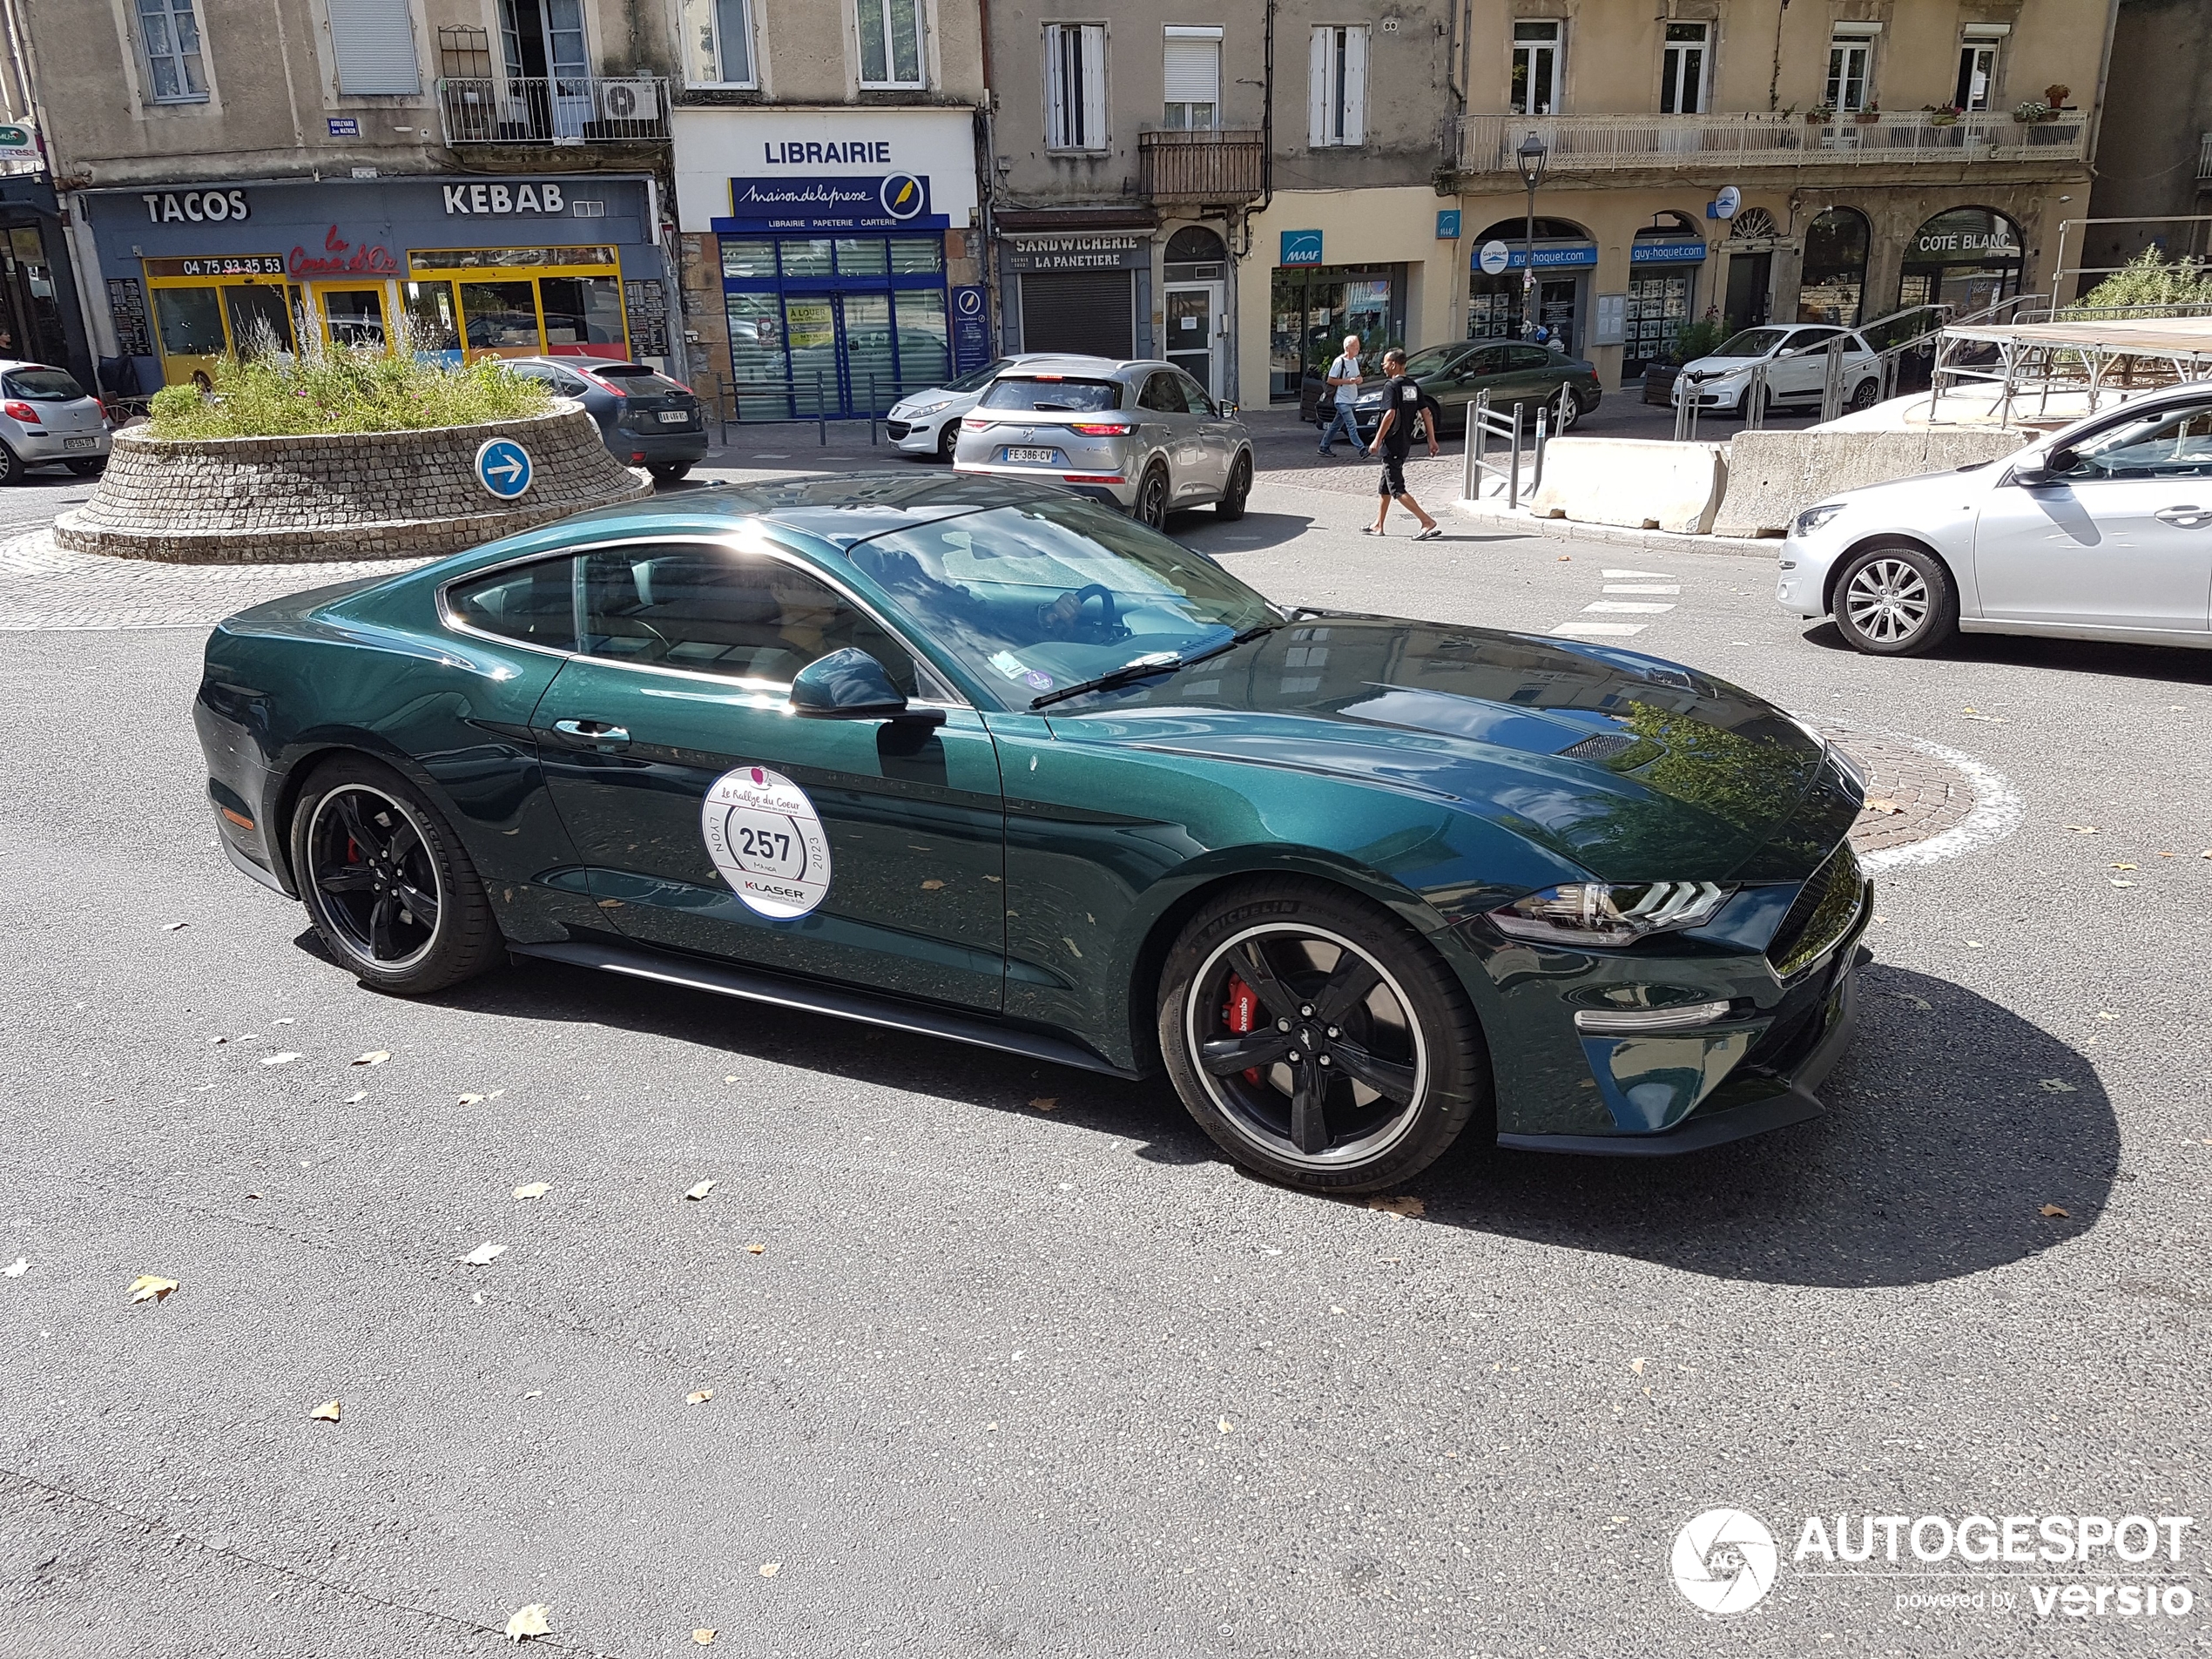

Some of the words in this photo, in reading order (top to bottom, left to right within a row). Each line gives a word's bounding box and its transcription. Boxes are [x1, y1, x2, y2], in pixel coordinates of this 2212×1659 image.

[764, 142, 891, 164] LIBRAIRIE
[143, 190, 248, 223] TACOS
[442, 184, 564, 214] KEBAB
[739, 184, 874, 209] maisondelapresse
[860, 218, 897, 226] CARTERIE
[1016, 236, 1137, 253] SANDWICHERIE
[1919, 232, 1958, 252] COTÉ
[1962, 233, 2011, 250] BLANC
[1035, 256, 1050, 268] LA
[1053, 254, 1121, 267] PANETIERE
[1286, 250, 1320, 261] MAAF
[1635, 246, 1702, 260] guy-hoquet.com
[183, 260, 200, 275] 04
[203, 260, 220, 274] 75
[224, 259, 240, 274] 93
[244, 259, 260, 273] 35
[264, 258, 281, 273] 53
[790, 307, 797, 317] À
[799, 308, 826, 317] LOUER
[1008, 449, 1052, 461] FE-386-CV
[721, 786, 731, 799] Le
[732, 789, 760, 807] Rallye
[763, 794, 774, 805] du
[777, 797, 800, 810] Coeur
[709, 816, 725, 853] LYON
[739, 827, 791, 862] 257
[809, 837, 823, 870] 2023
[1238, 997, 1248, 1032] brembo
